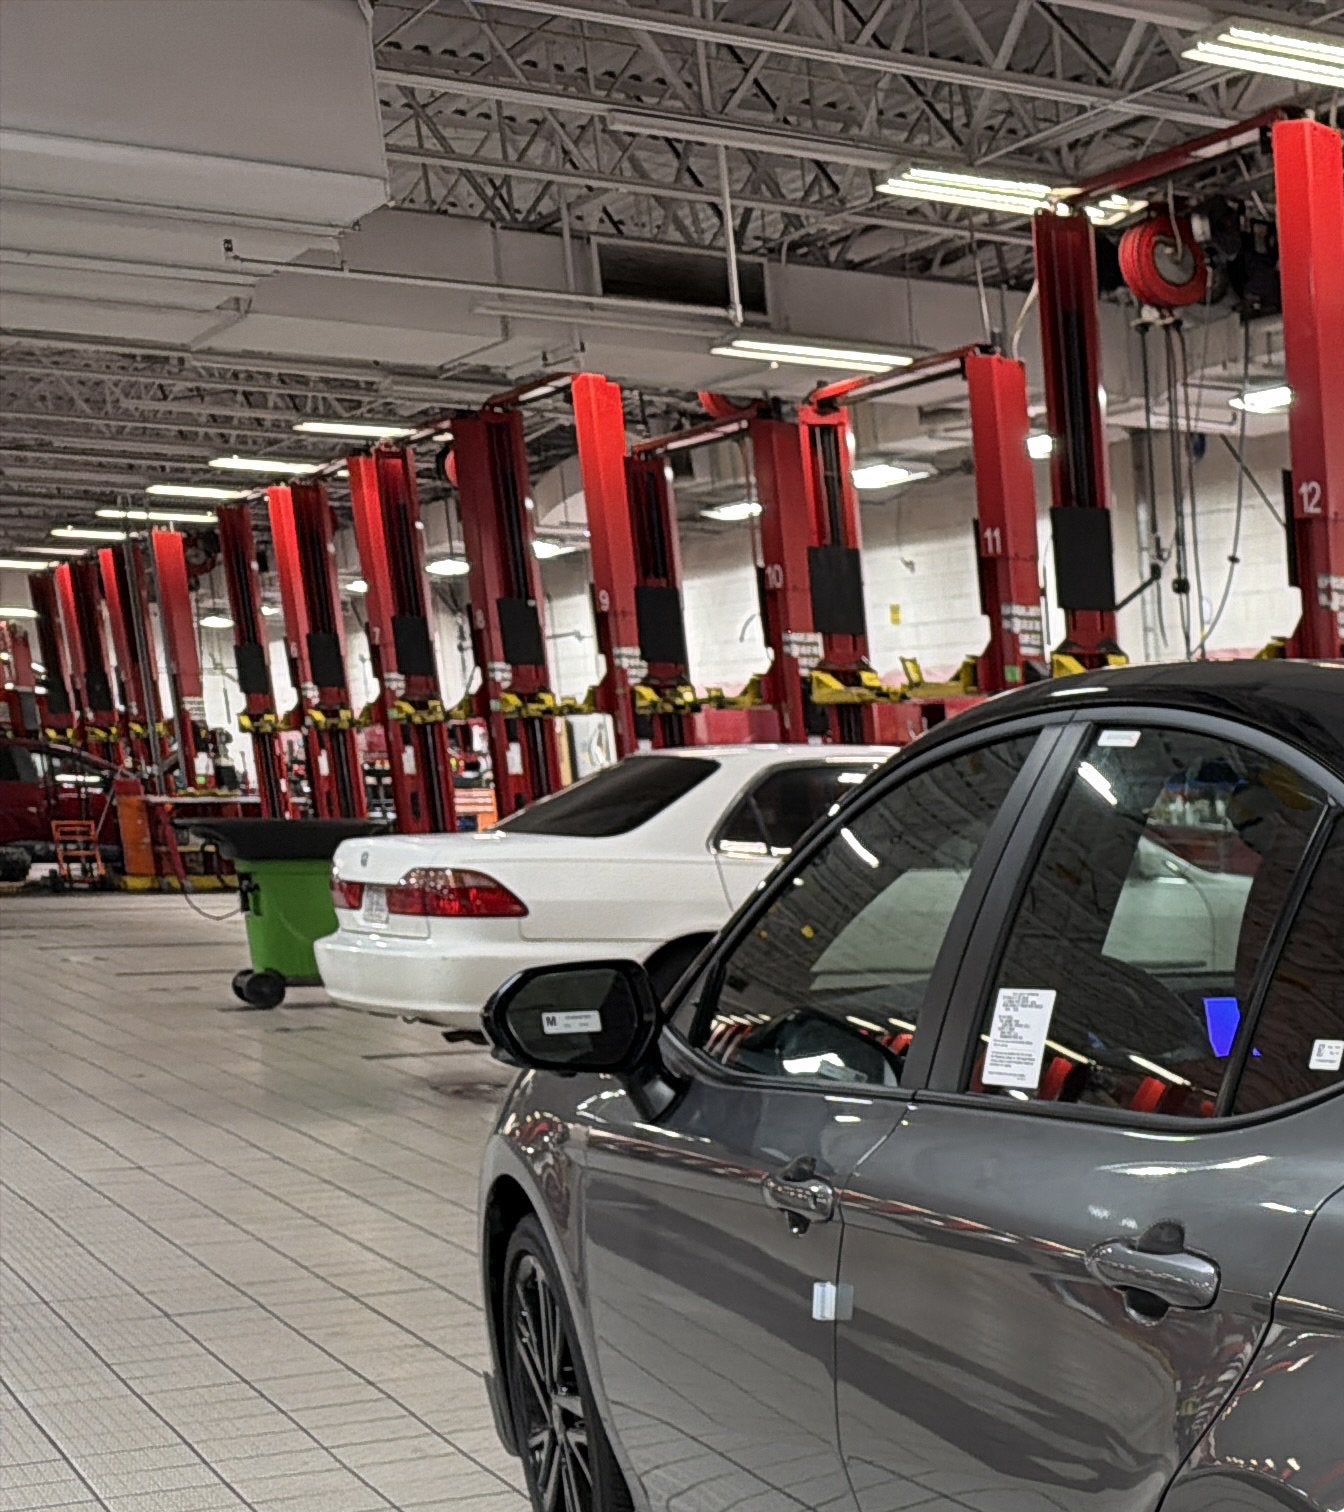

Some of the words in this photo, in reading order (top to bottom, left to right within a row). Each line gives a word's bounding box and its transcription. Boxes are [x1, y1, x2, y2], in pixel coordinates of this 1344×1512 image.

[1298, 480, 1322, 515] 12
[983, 526, 1002, 556] 11
[764, 564, 784, 589] 10
[599, 588, 610, 612] 9
